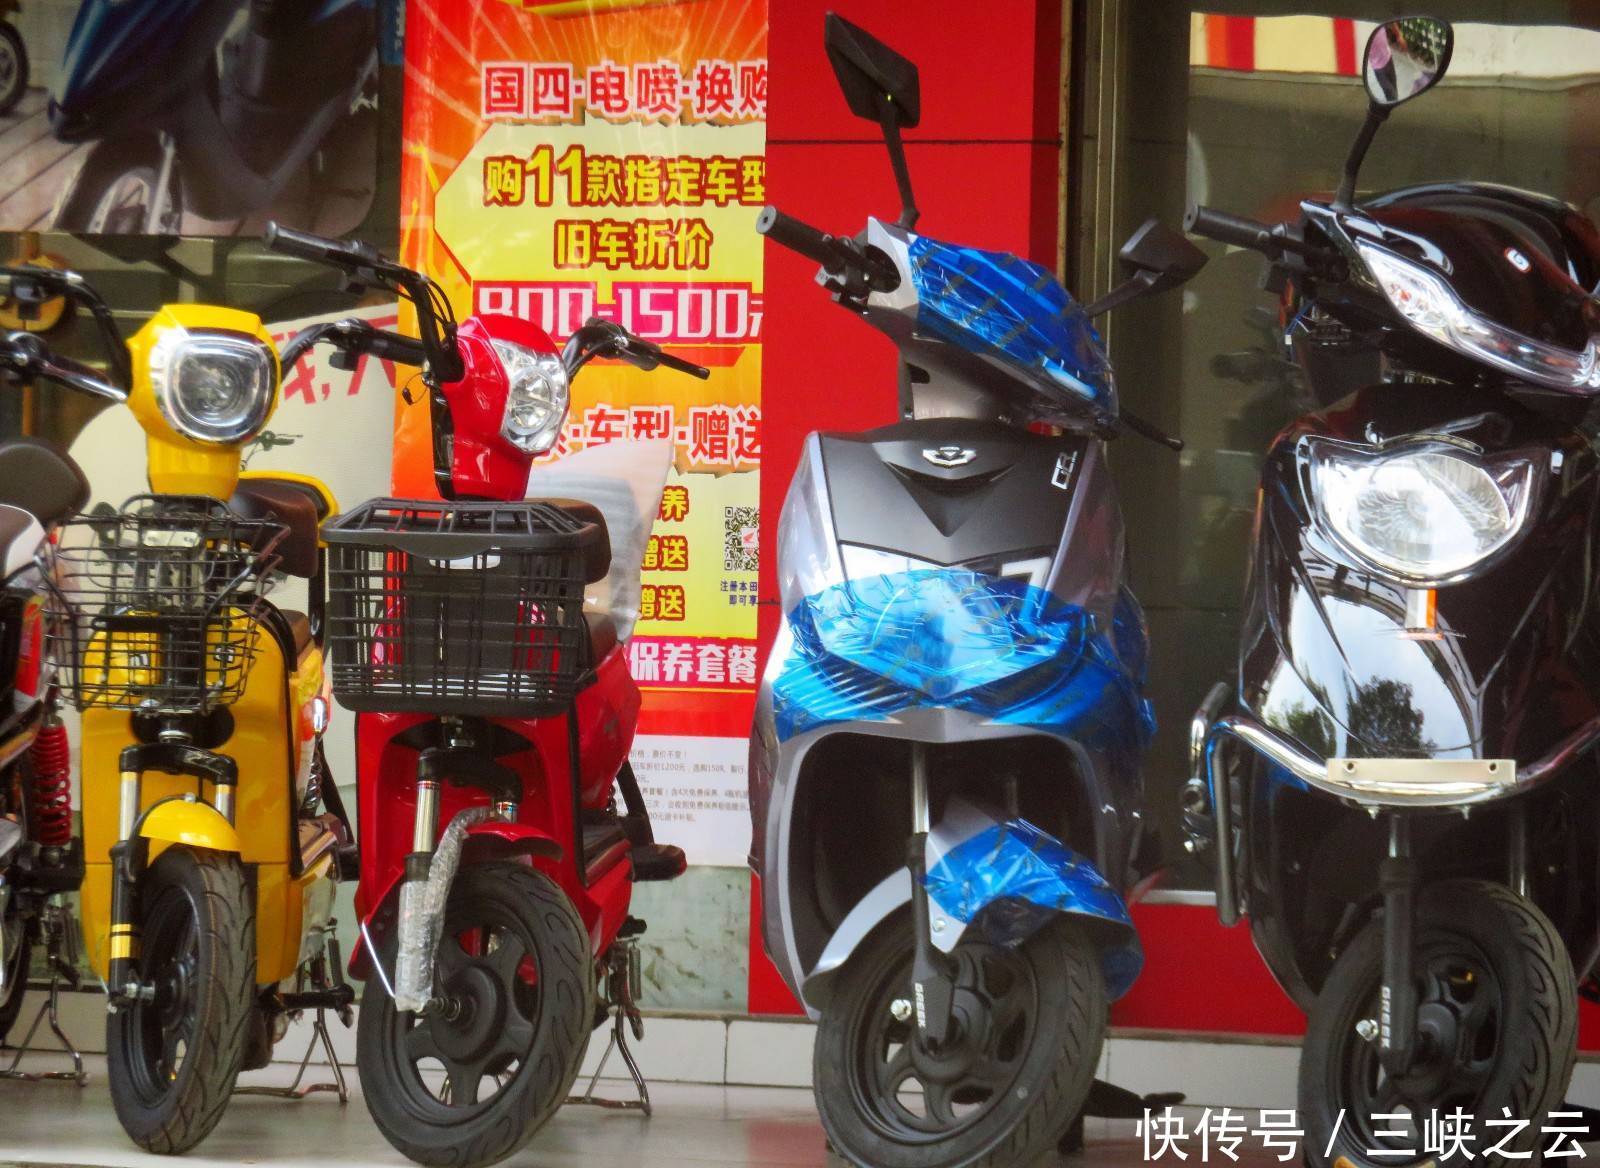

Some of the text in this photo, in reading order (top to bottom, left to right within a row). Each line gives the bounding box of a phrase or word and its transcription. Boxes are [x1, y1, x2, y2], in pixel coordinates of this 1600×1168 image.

[554, 218, 713, 270] 旧车折价
[658, 486, 689, 521] 养
[629, 642, 757, 684] 保养套餐
